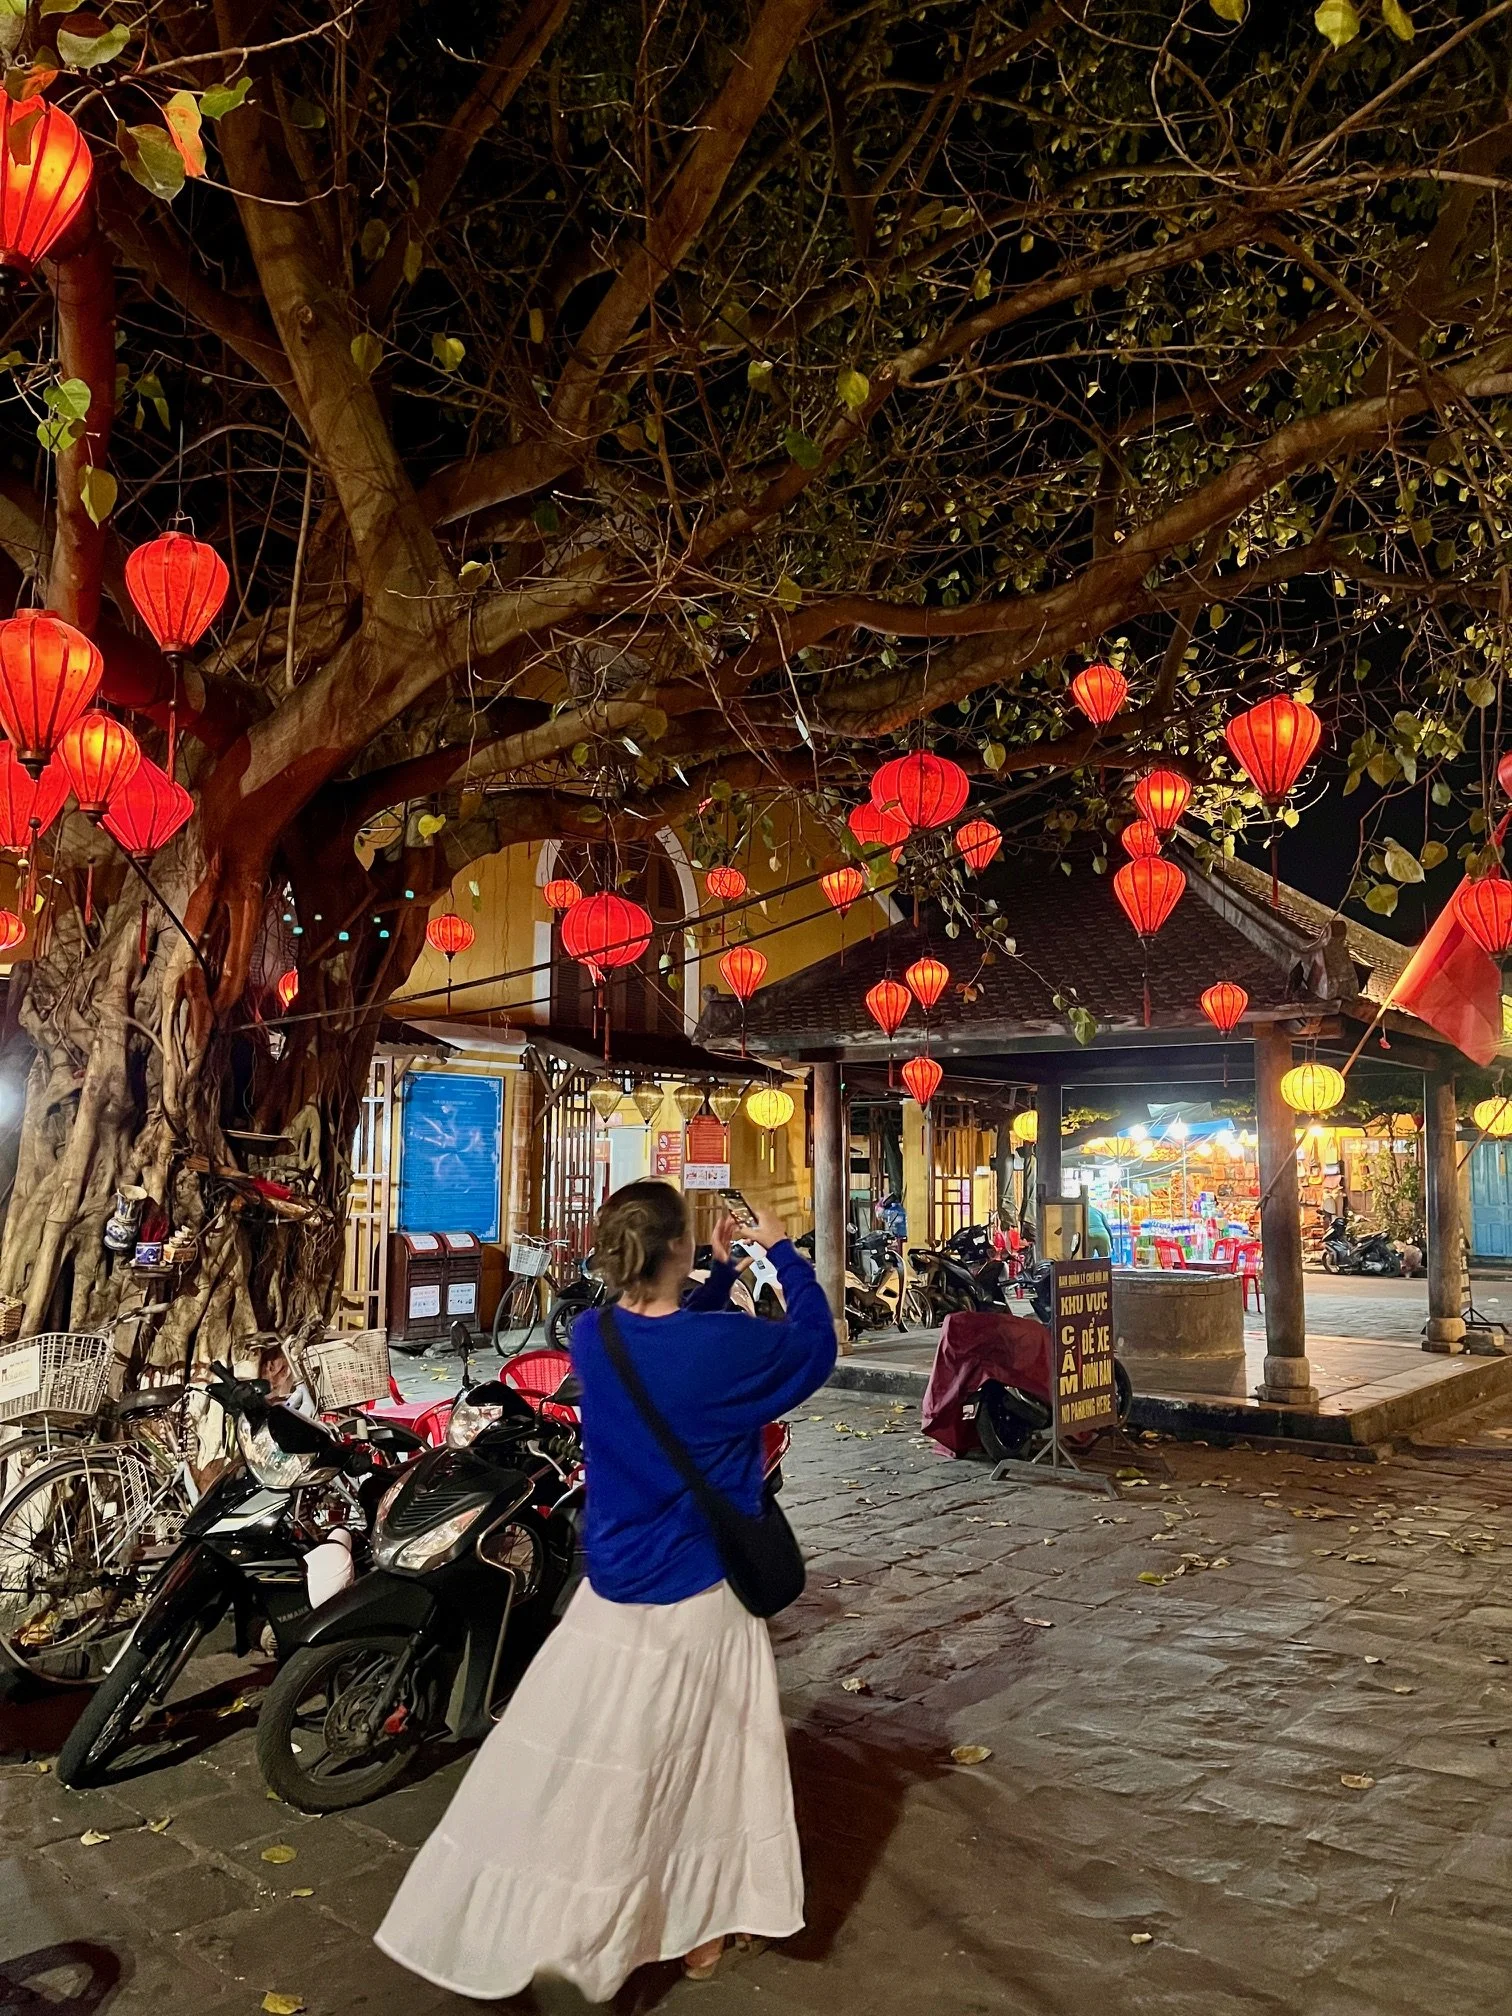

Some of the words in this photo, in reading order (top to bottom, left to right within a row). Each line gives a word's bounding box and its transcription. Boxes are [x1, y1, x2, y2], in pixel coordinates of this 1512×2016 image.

[1061, 1295, 1083, 1316] KHU
[1086, 1292, 1107, 1315] VỰC
[1097, 1326, 1109, 1352] XE
[1099, 1354, 1111, 1386] BÁN
[1062, 1404, 1070, 1424] NO
[1071, 1398, 1095, 1421] PARKING
[1096, 1394, 1111, 1416] HERE
[277, 1605, 310, 1622] YAMAHA
